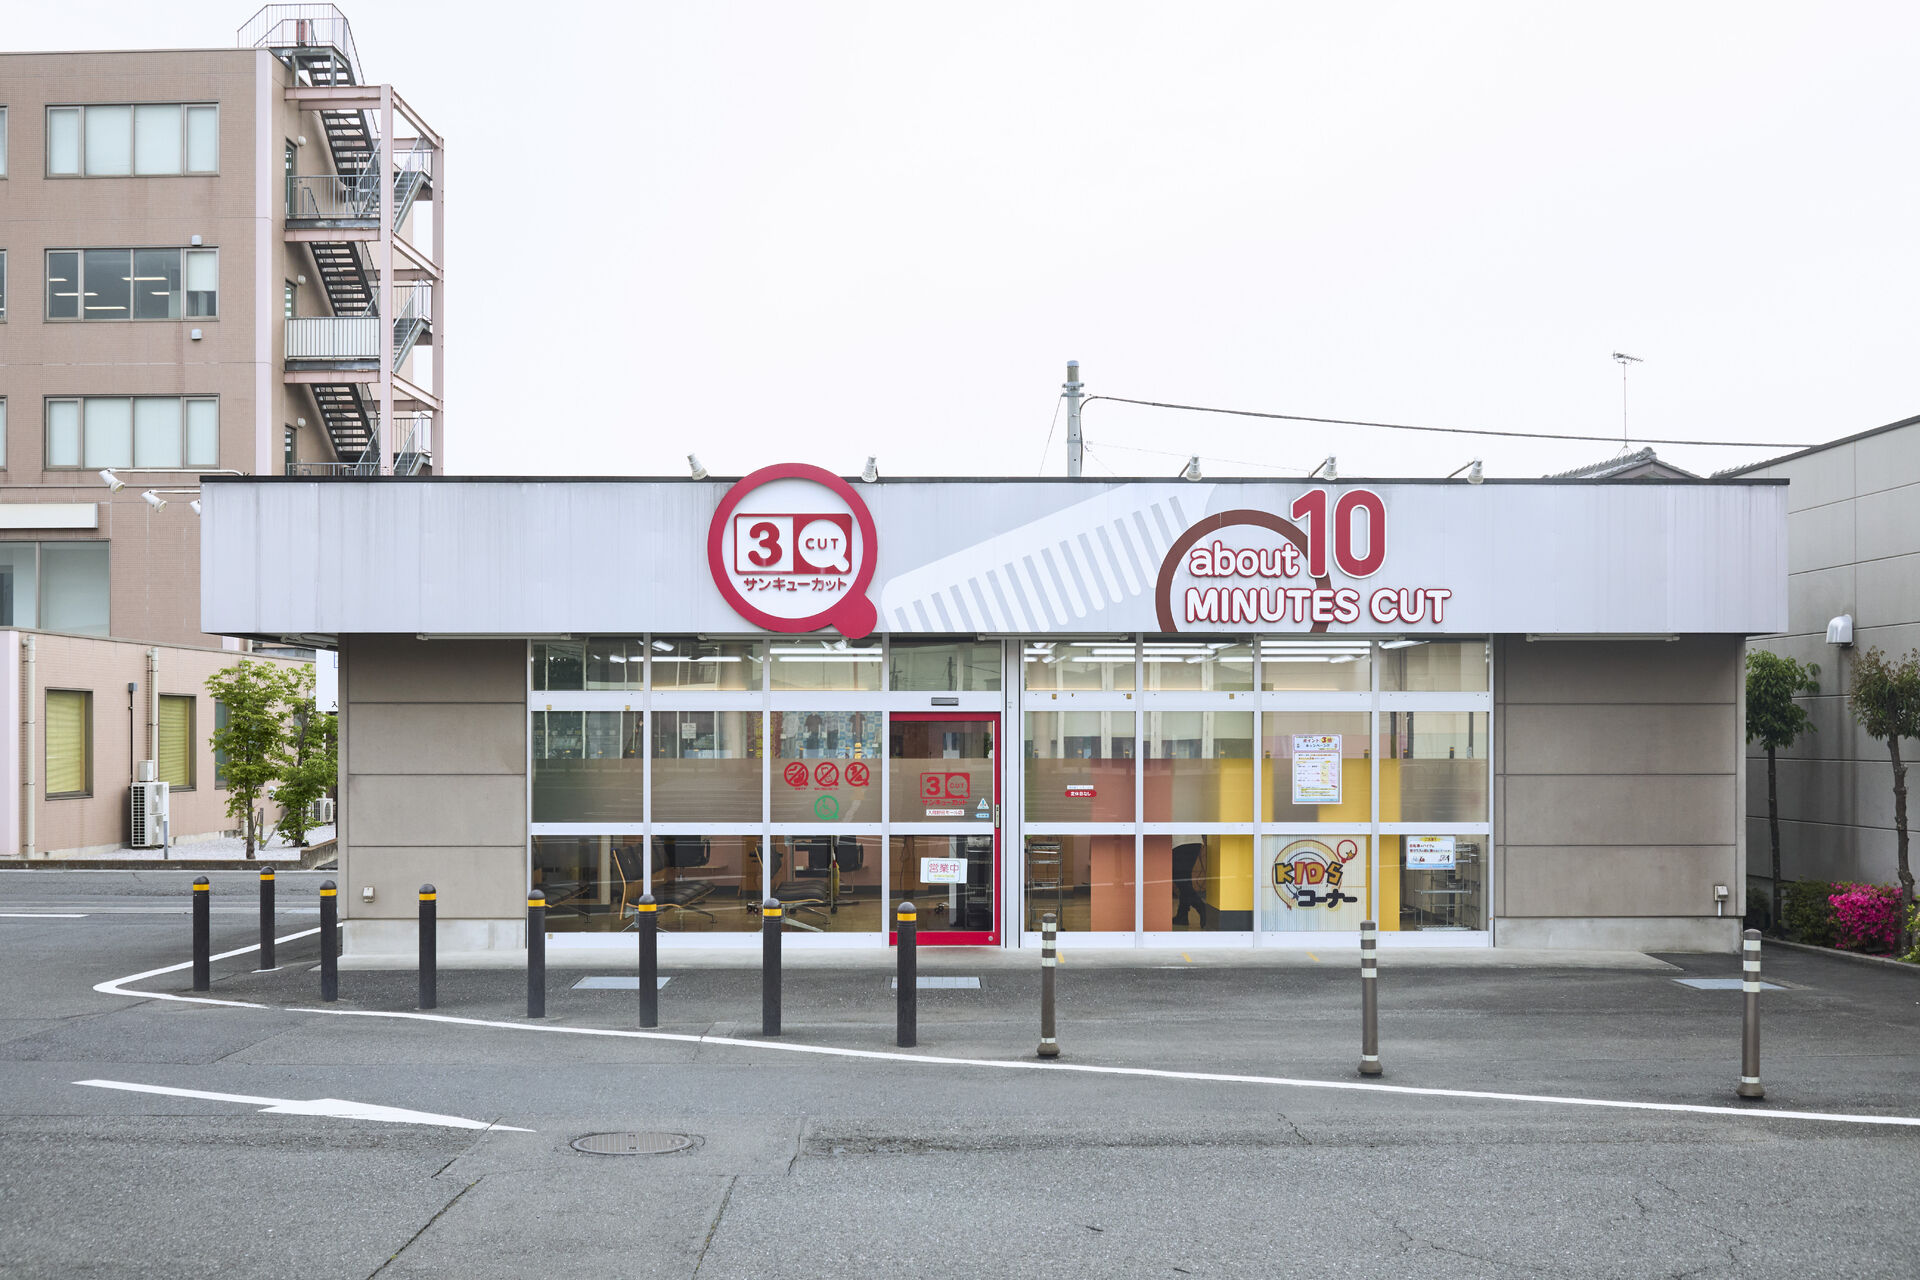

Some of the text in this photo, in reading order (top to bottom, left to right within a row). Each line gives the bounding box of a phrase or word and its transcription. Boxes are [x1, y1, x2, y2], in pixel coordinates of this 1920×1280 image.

[805, 537, 839, 550] CUT
[1189, 488, 1387, 579] about 10
[743, 577, 847, 592] サンキューカット
[1185, 586, 1452, 624] MINUTES CUT
[928, 863, 960, 873] 営業中
[1274, 861, 1343, 886] KIDS
[1297, 889, 1358, 909] コーナー
